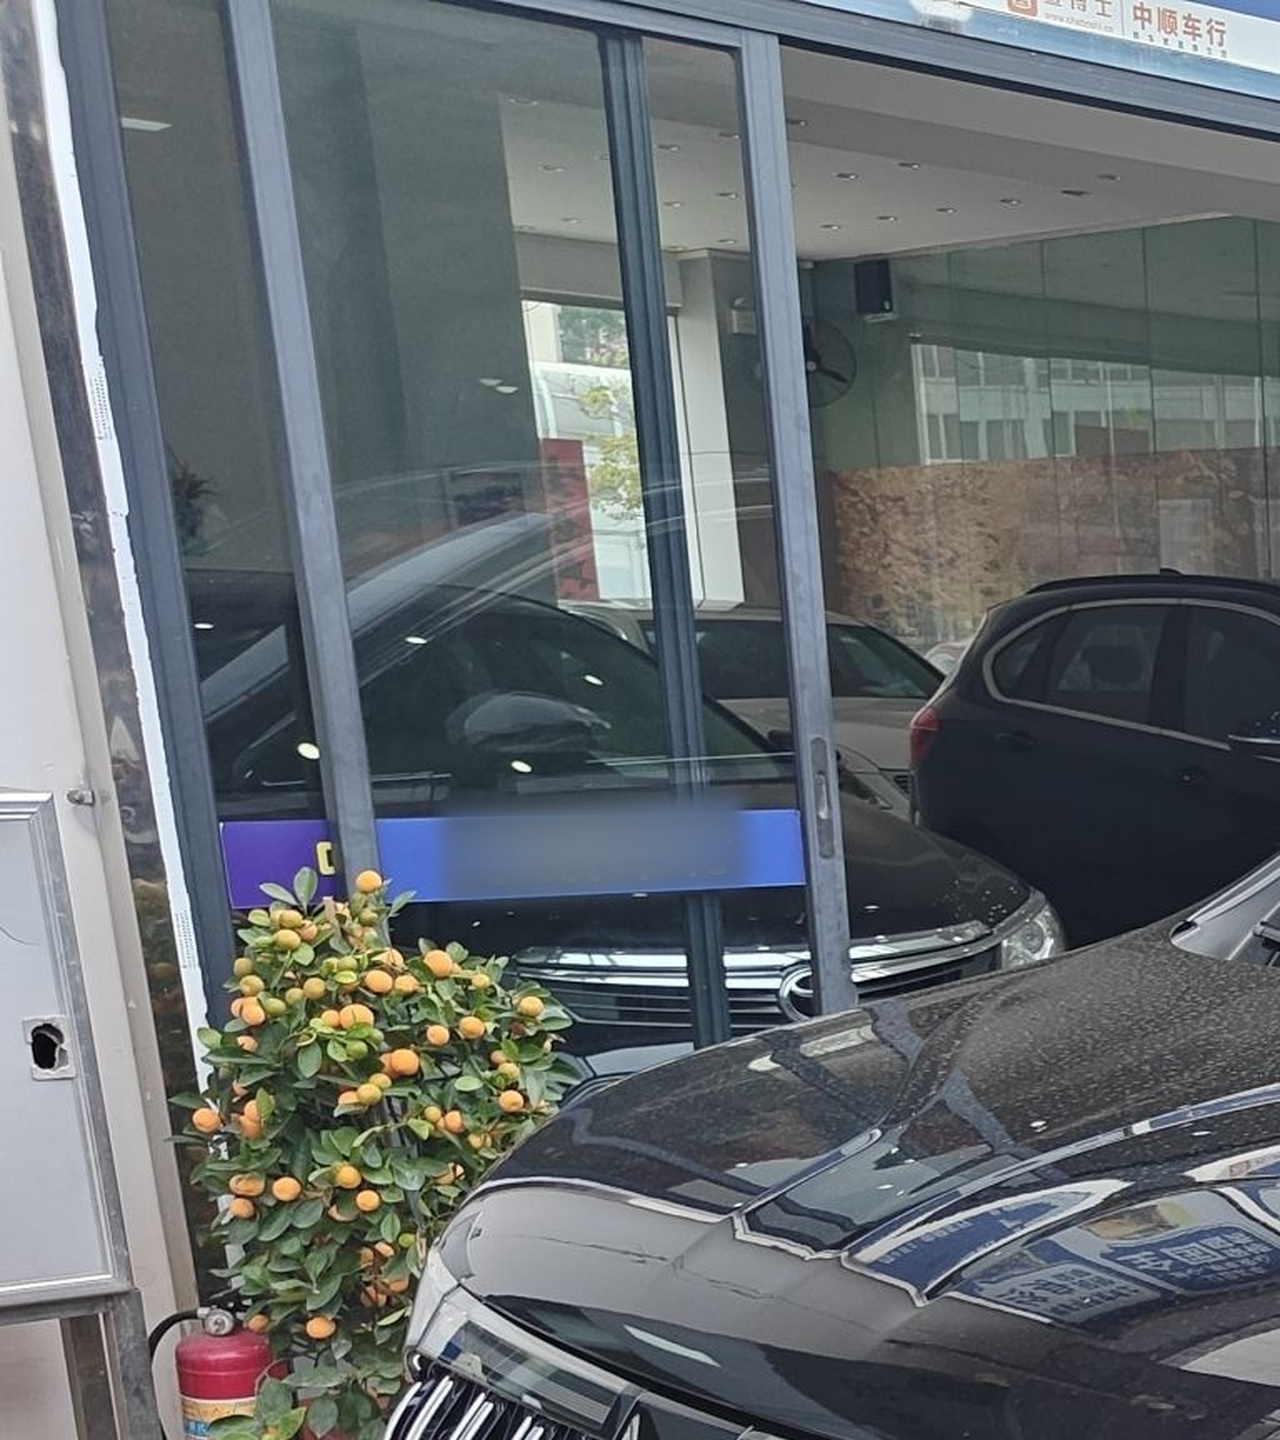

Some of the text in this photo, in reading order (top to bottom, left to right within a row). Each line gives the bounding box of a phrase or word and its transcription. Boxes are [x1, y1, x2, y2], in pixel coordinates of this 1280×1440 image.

[1045, 0, 1112, 18] 博士
[1133, 2, 1226, 48] 中顺车行
